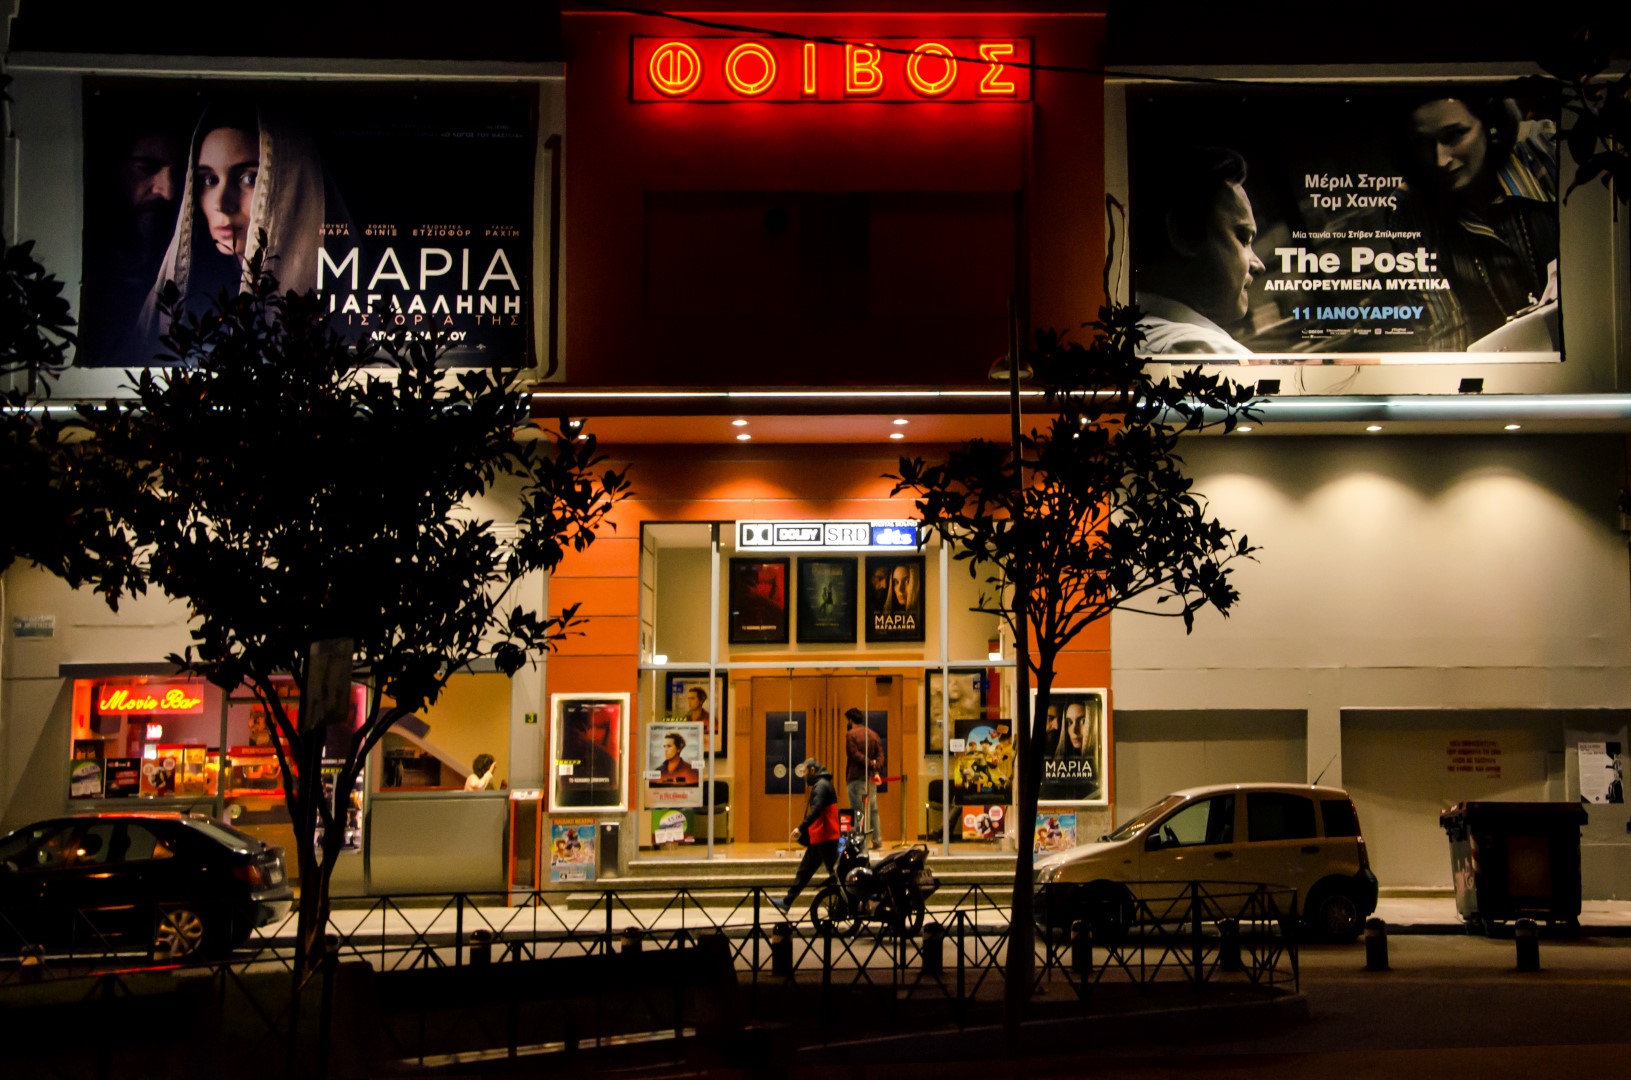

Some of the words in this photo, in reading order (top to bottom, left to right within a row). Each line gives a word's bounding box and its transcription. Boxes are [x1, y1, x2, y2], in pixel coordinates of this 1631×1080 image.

[649, 42, 1014, 94] ΦΟΙΒΟΣ
[1304, 173, 1353, 191] Μέριλ
[1357, 174, 1403, 191] Στριπ
[1310, 193, 1341, 211] Τομ
[1346, 193, 1397, 211] Χανκς
[1292, 230, 1307, 239] Μία
[1308, 230, 1331, 239] ταινία
[1332, 230, 1346, 239] του
[1347, 230, 1373, 240] Στίβεν
[1374, 230, 1421, 240] Σπίλμπεργκ
[1274, 247, 1340, 274] The
[1351, 247, 1437, 274] Post:
[316, 246, 520, 291] ΜΑΡΙΑ
[1264, 279, 1383, 291] ΑΠΑΓΟΡΕΥΜΕΝΑ
[1385, 278, 1451, 291] ΜΥΣΤΙΚΑ
[1292, 306, 1310, 320] 11
[1316, 305, 1424, 320] ΙΑΝΟΥΑΡΙΟΥ
[474, 314, 519, 327] ΤΗΣ
[779, 528, 818, 541] DOLBY
[827, 528, 867, 541] SRD
[876, 528, 913, 545] dts
[874, 614, 915, 625] ΜΑΡΙΑ
[99, 690, 158, 711] Movie
[160, 689, 201, 710] Bar
[1045, 760, 1092, 772] ΜΑΡΙΑ
